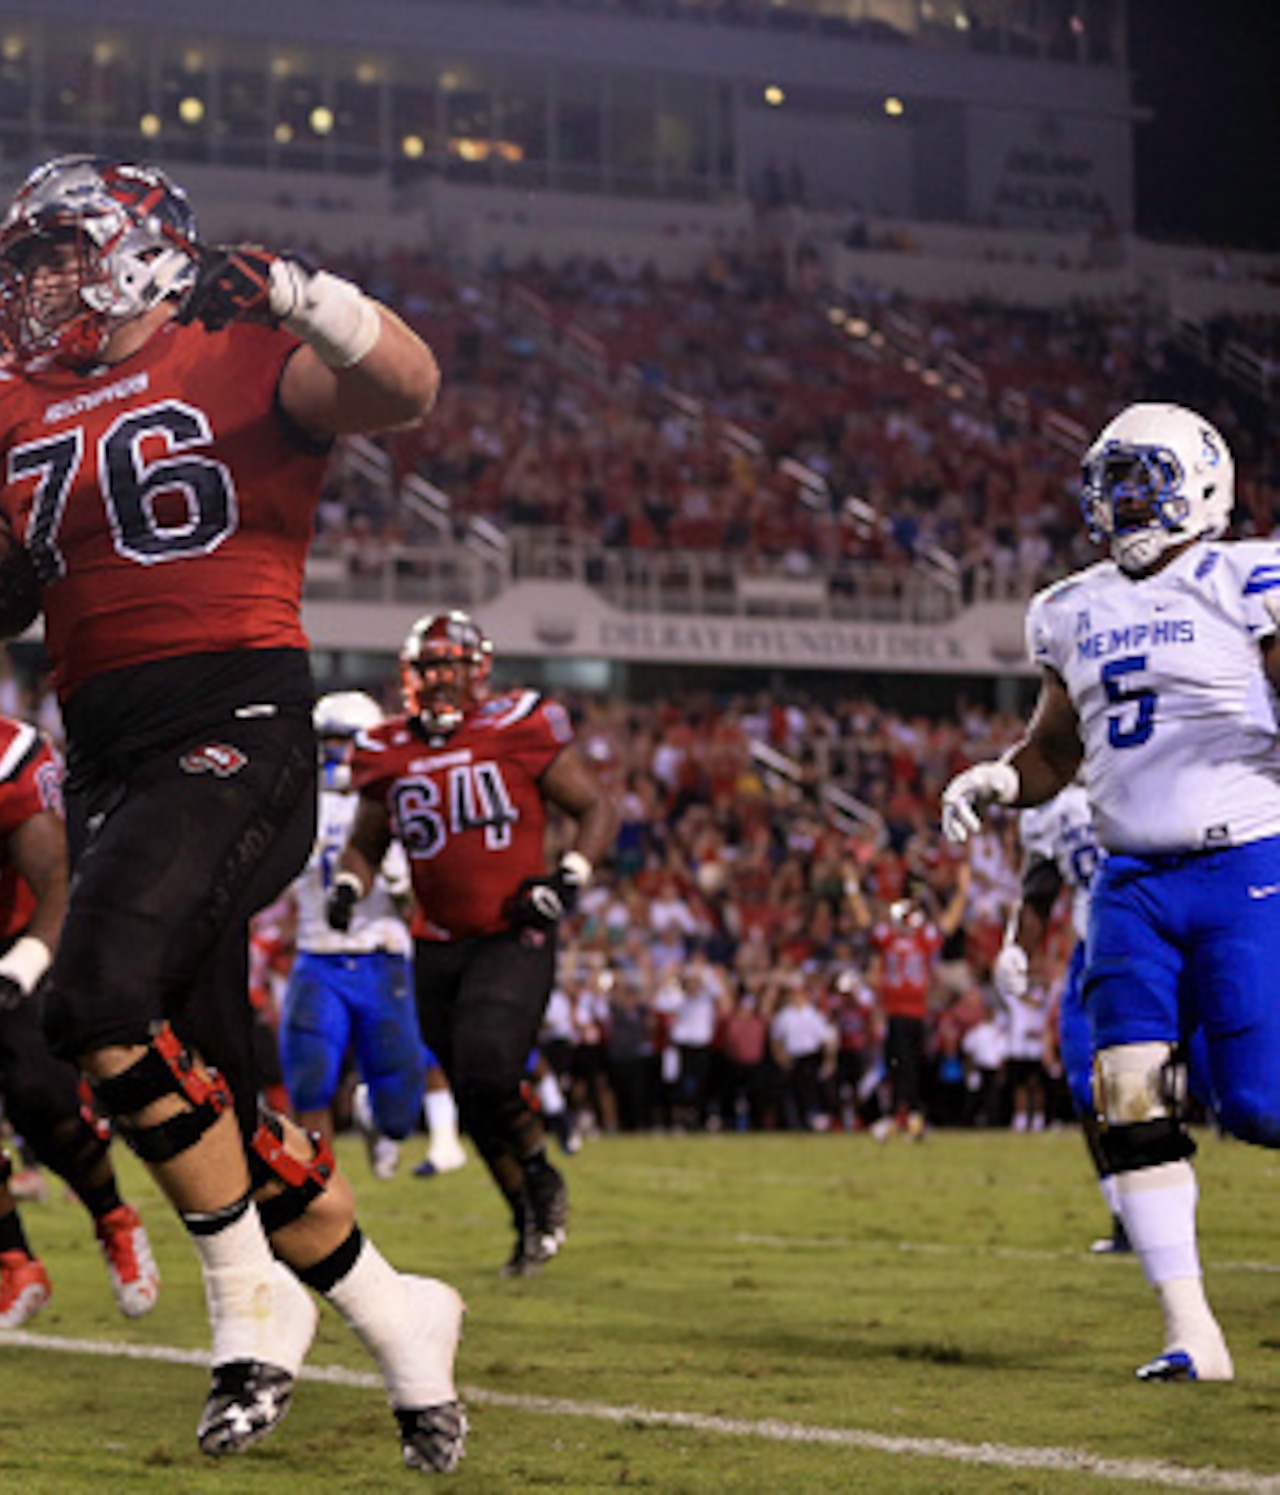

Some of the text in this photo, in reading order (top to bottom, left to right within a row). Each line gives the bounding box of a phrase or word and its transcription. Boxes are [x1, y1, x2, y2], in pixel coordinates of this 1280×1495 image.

[993, 183, 1110, 217] ACURA
[6, 398, 239, 586] 76
[598, 622, 965, 659] DELRAY HYUNDAI DECK
[1076, 620, 1196, 661] MEMPHIS
[1099, 655, 1160, 748] 5
[387, 761, 520, 860] 64
